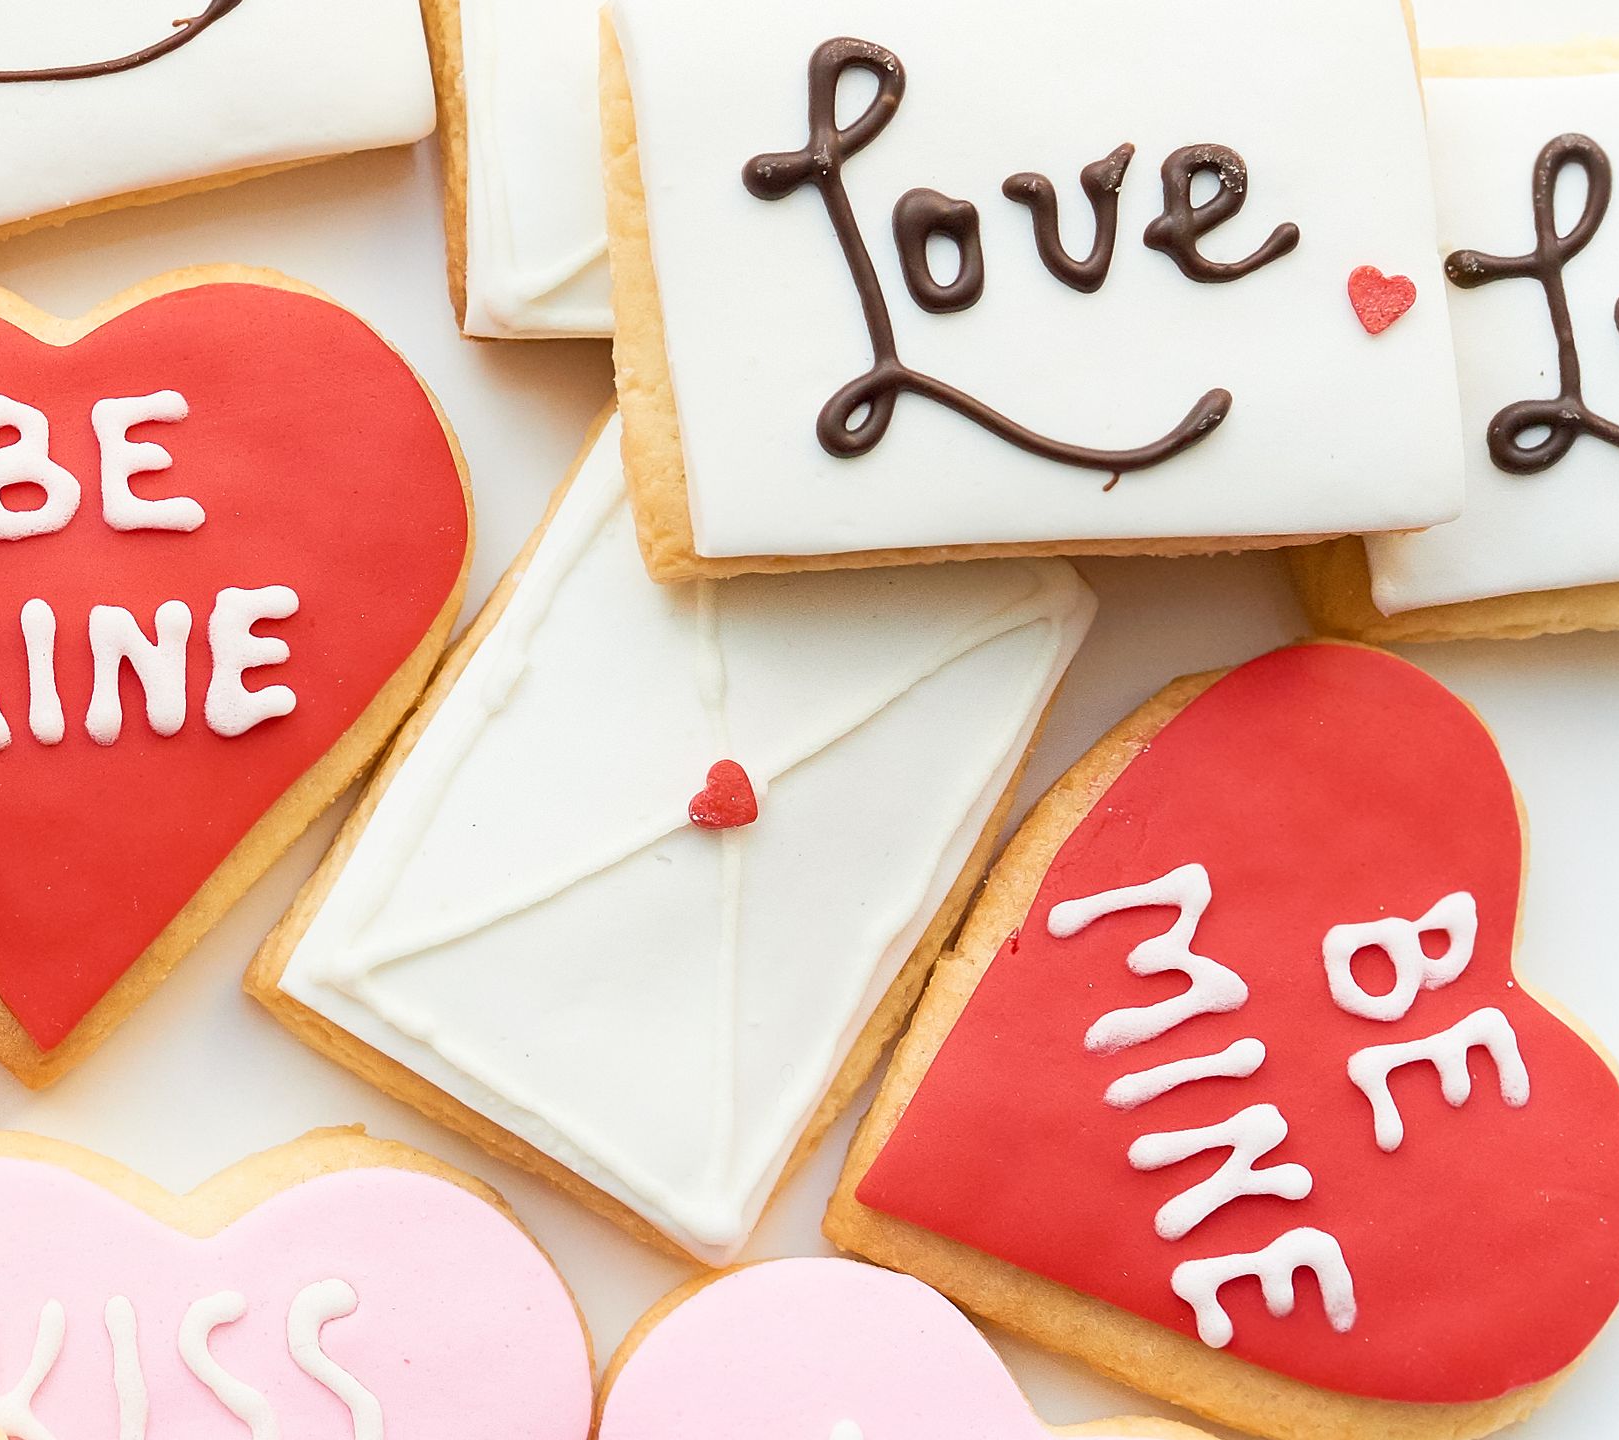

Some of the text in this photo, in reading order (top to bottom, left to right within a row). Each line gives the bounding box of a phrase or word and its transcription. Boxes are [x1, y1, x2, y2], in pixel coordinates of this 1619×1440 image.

[741, 36, 1300, 491] Love
[1047, 862, 1357, 1349] MINE
[1322, 891, 1531, 1153] BE
